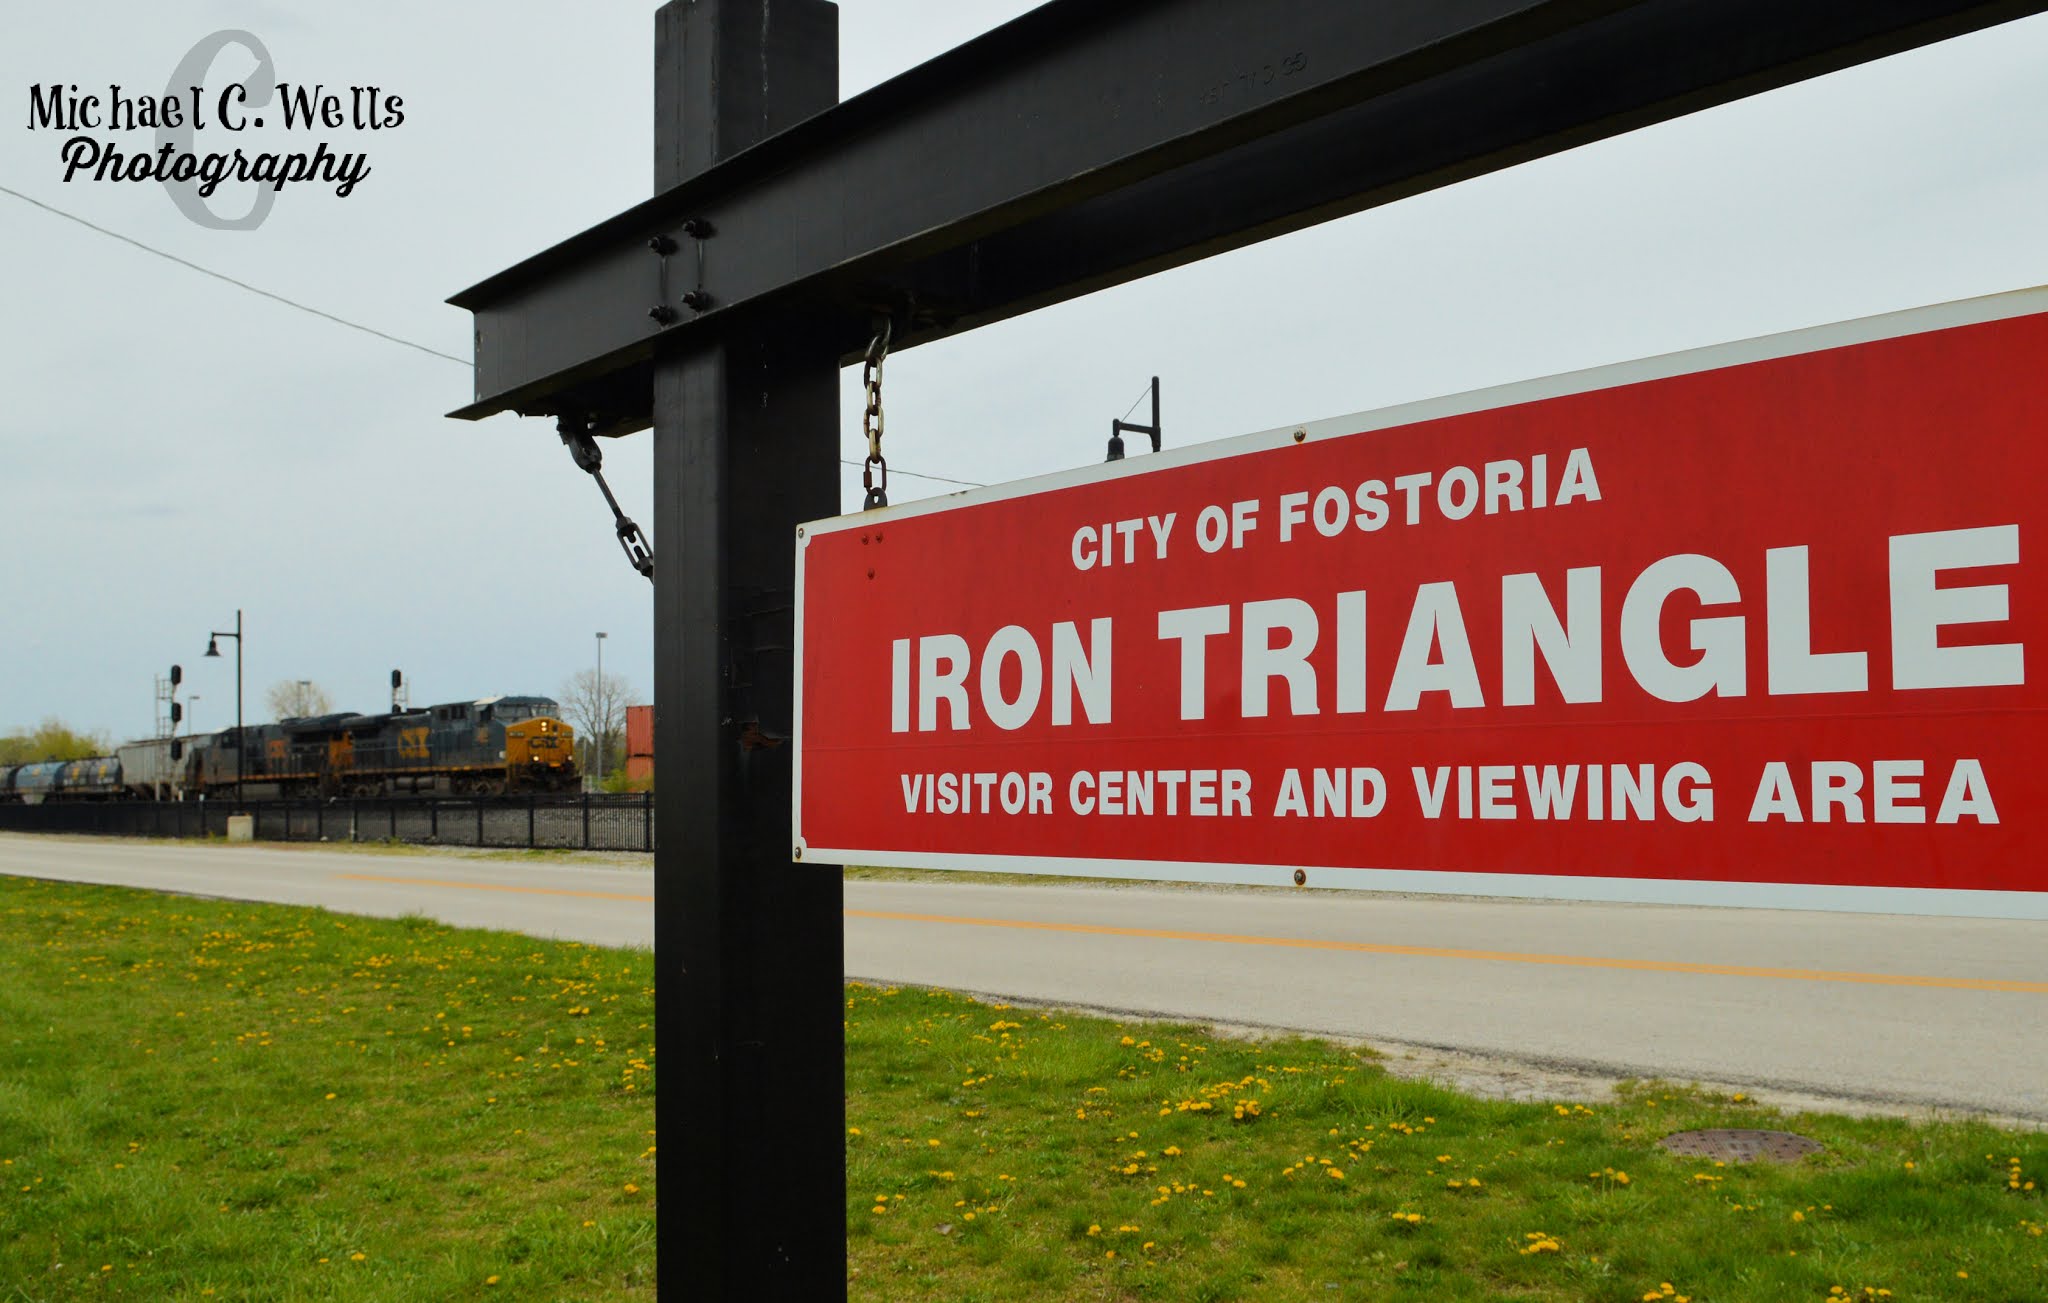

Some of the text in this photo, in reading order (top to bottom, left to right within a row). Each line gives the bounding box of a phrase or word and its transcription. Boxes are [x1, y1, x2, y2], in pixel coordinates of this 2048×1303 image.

[1071, 447, 1602, 571] CITY OF FOSTORIA
[891, 523, 2025, 733] IRON TRIANGLE
[900, 758, 2000, 825] VISITOR CENTER AND VIEWING AREA
